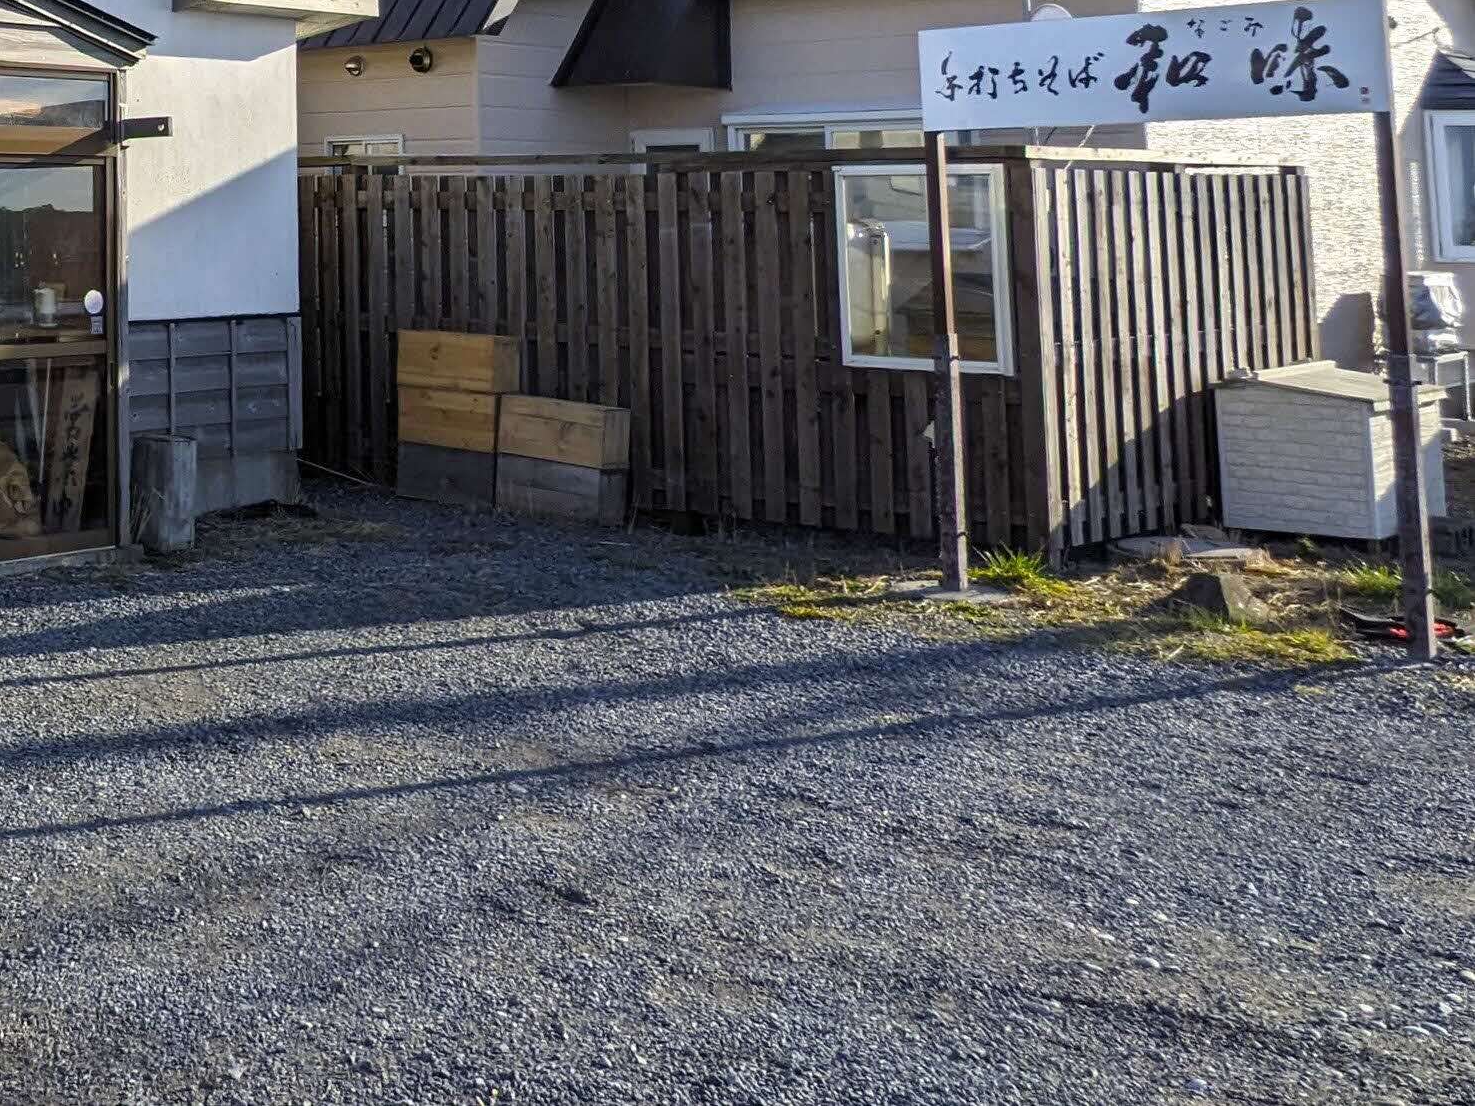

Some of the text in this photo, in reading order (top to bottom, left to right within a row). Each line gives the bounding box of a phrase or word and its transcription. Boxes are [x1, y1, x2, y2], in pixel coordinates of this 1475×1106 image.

[935, 51, 1104, 102] 手打ちそば
